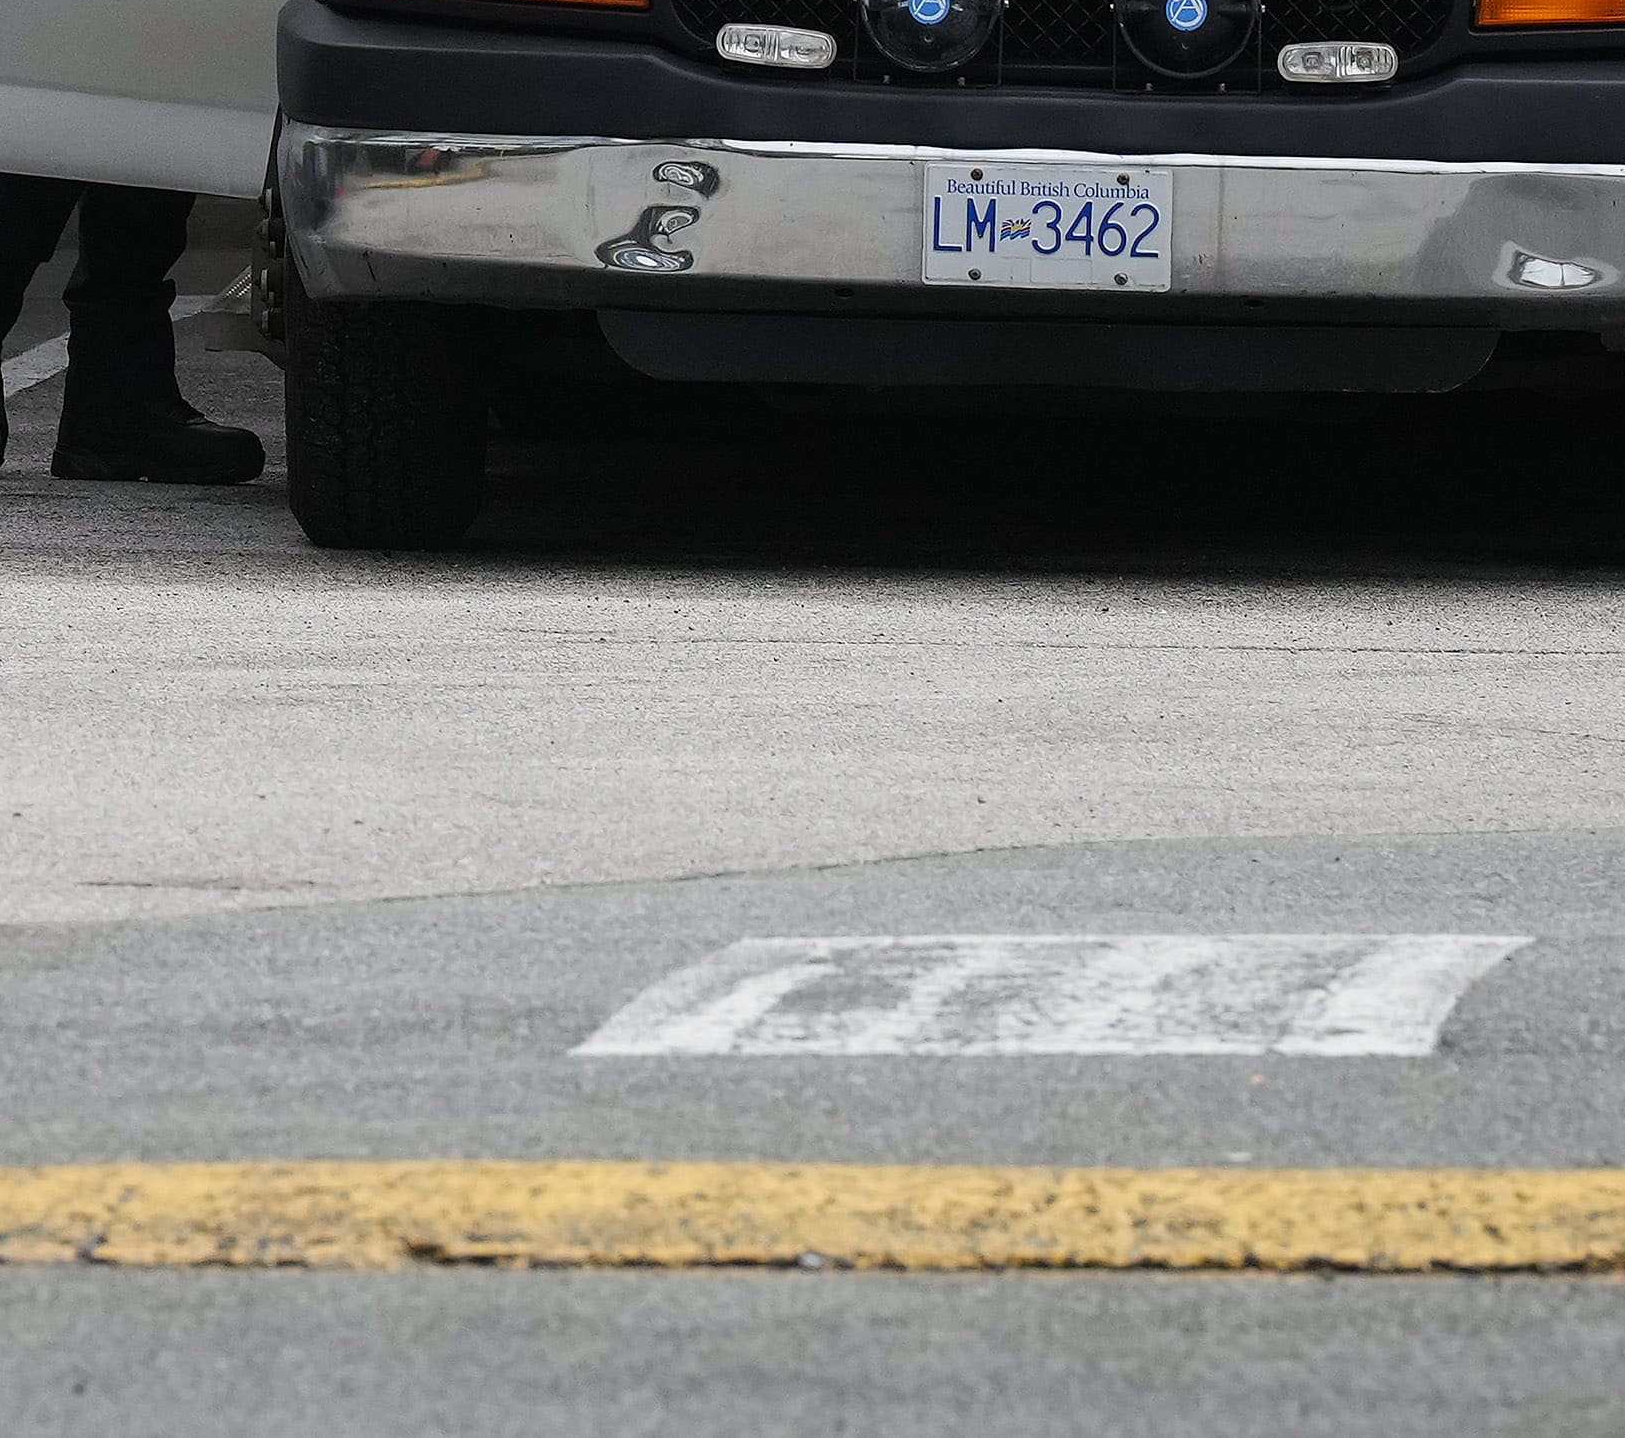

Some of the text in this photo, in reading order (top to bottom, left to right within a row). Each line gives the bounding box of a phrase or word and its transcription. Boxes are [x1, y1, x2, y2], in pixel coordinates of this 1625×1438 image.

[947, 179, 1150, 200] Beautiful British Columbia
[933, 196, 1160, 258] LM 3462
